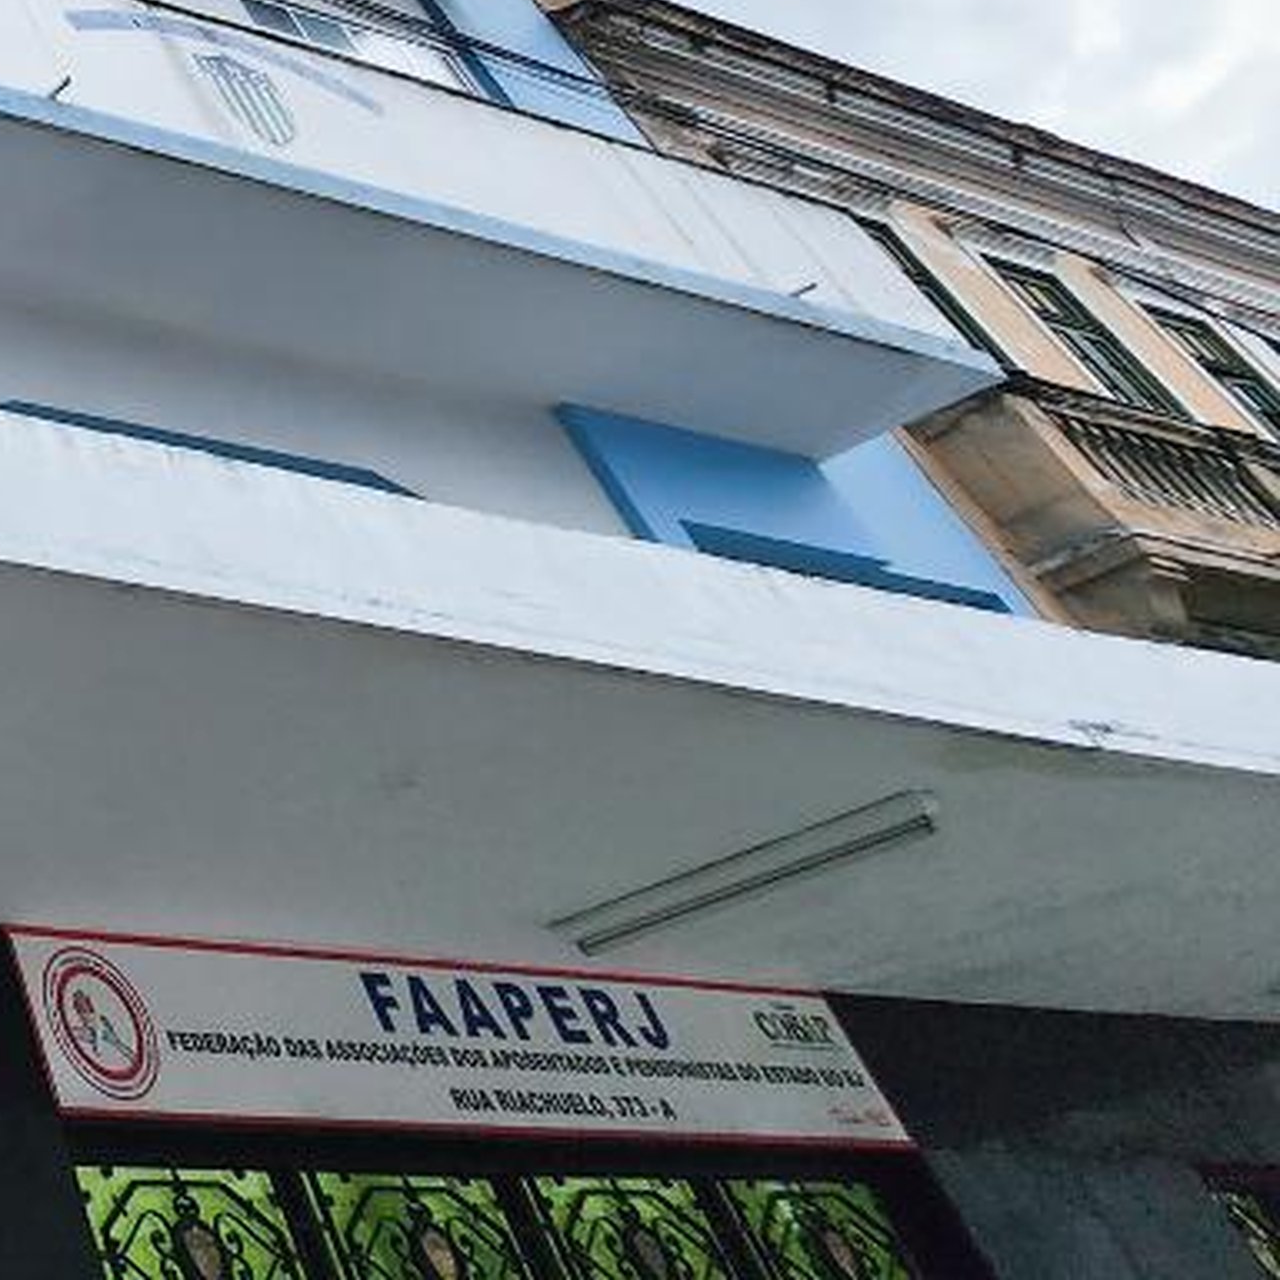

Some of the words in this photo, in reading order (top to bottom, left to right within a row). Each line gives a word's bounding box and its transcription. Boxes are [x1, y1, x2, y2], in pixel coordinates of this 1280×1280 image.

[359, 972, 670, 1050] FAAPERJ
[167, 1030, 281, 1059] FEDERAÇÃO
[284, 1035, 323, 1059] DAS
[326, 1039, 449, 1067] ASSOCIAÇÕES
[450, 1046, 490, 1068] DOS
[490, 1049, 609, 1075] APOSENTADOS
[609, 1056, 627, 1077] E
[449, 1088, 497, 1111] RUA
[611, 1096, 650, 1118] 373
[659, 1098, 678, 1120] A
